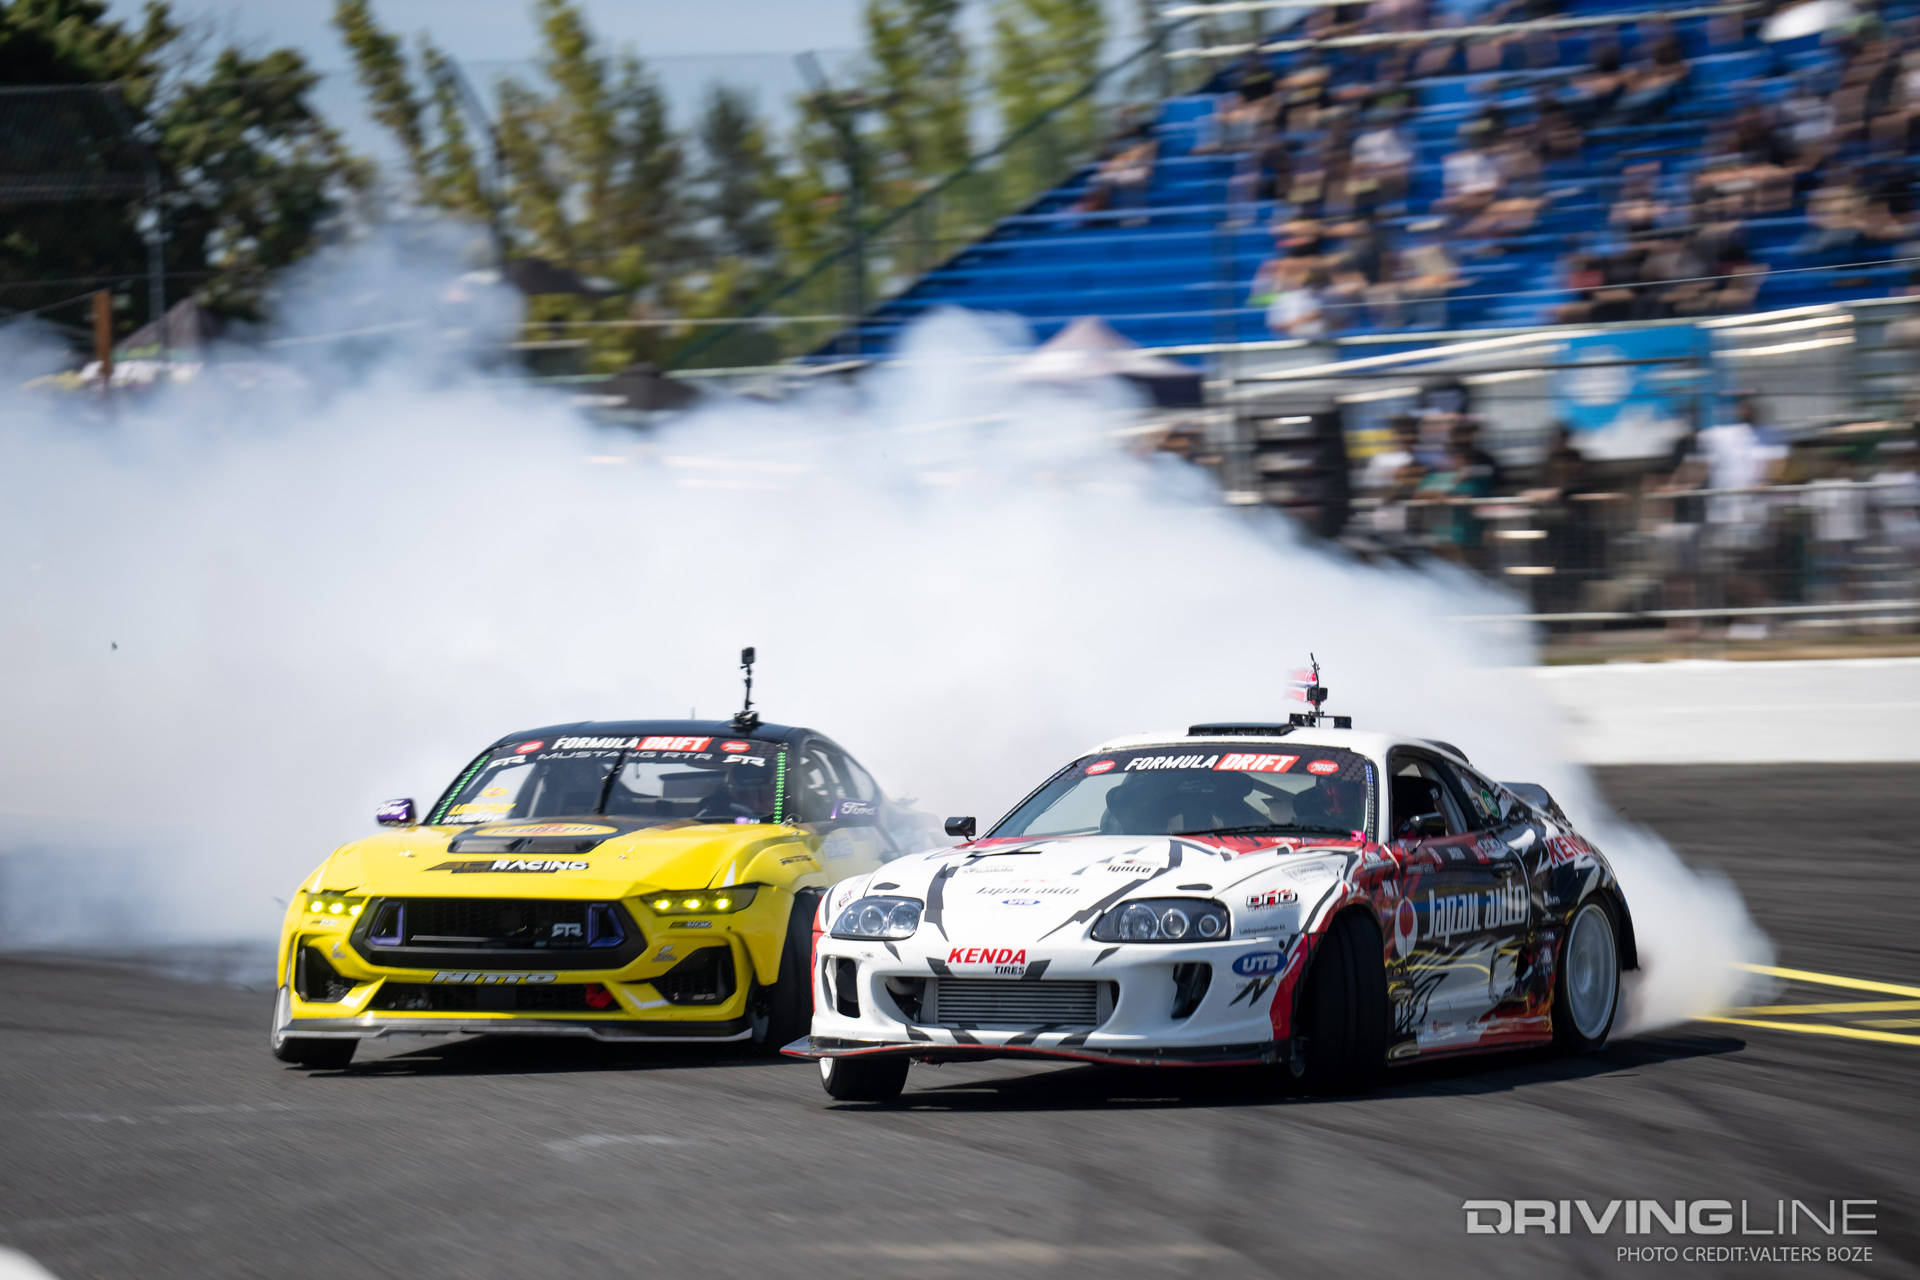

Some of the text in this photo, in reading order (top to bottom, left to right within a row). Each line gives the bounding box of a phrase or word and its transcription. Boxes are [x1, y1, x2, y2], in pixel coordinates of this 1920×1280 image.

[551, 737, 640, 750] FORMULA
[640, 736, 708, 750] DRIFT
[1124, 754, 1219, 771] FORMULA
[1219, 754, 1295, 772] DRIFT
[491, 859, 588, 871] RACING
[1422, 877, 1526, 948] Japan auto
[947, 948, 1027, 965] KENDA
[432, 971, 558, 984] NITTO
[993, 965, 1026, 976] TIRES
